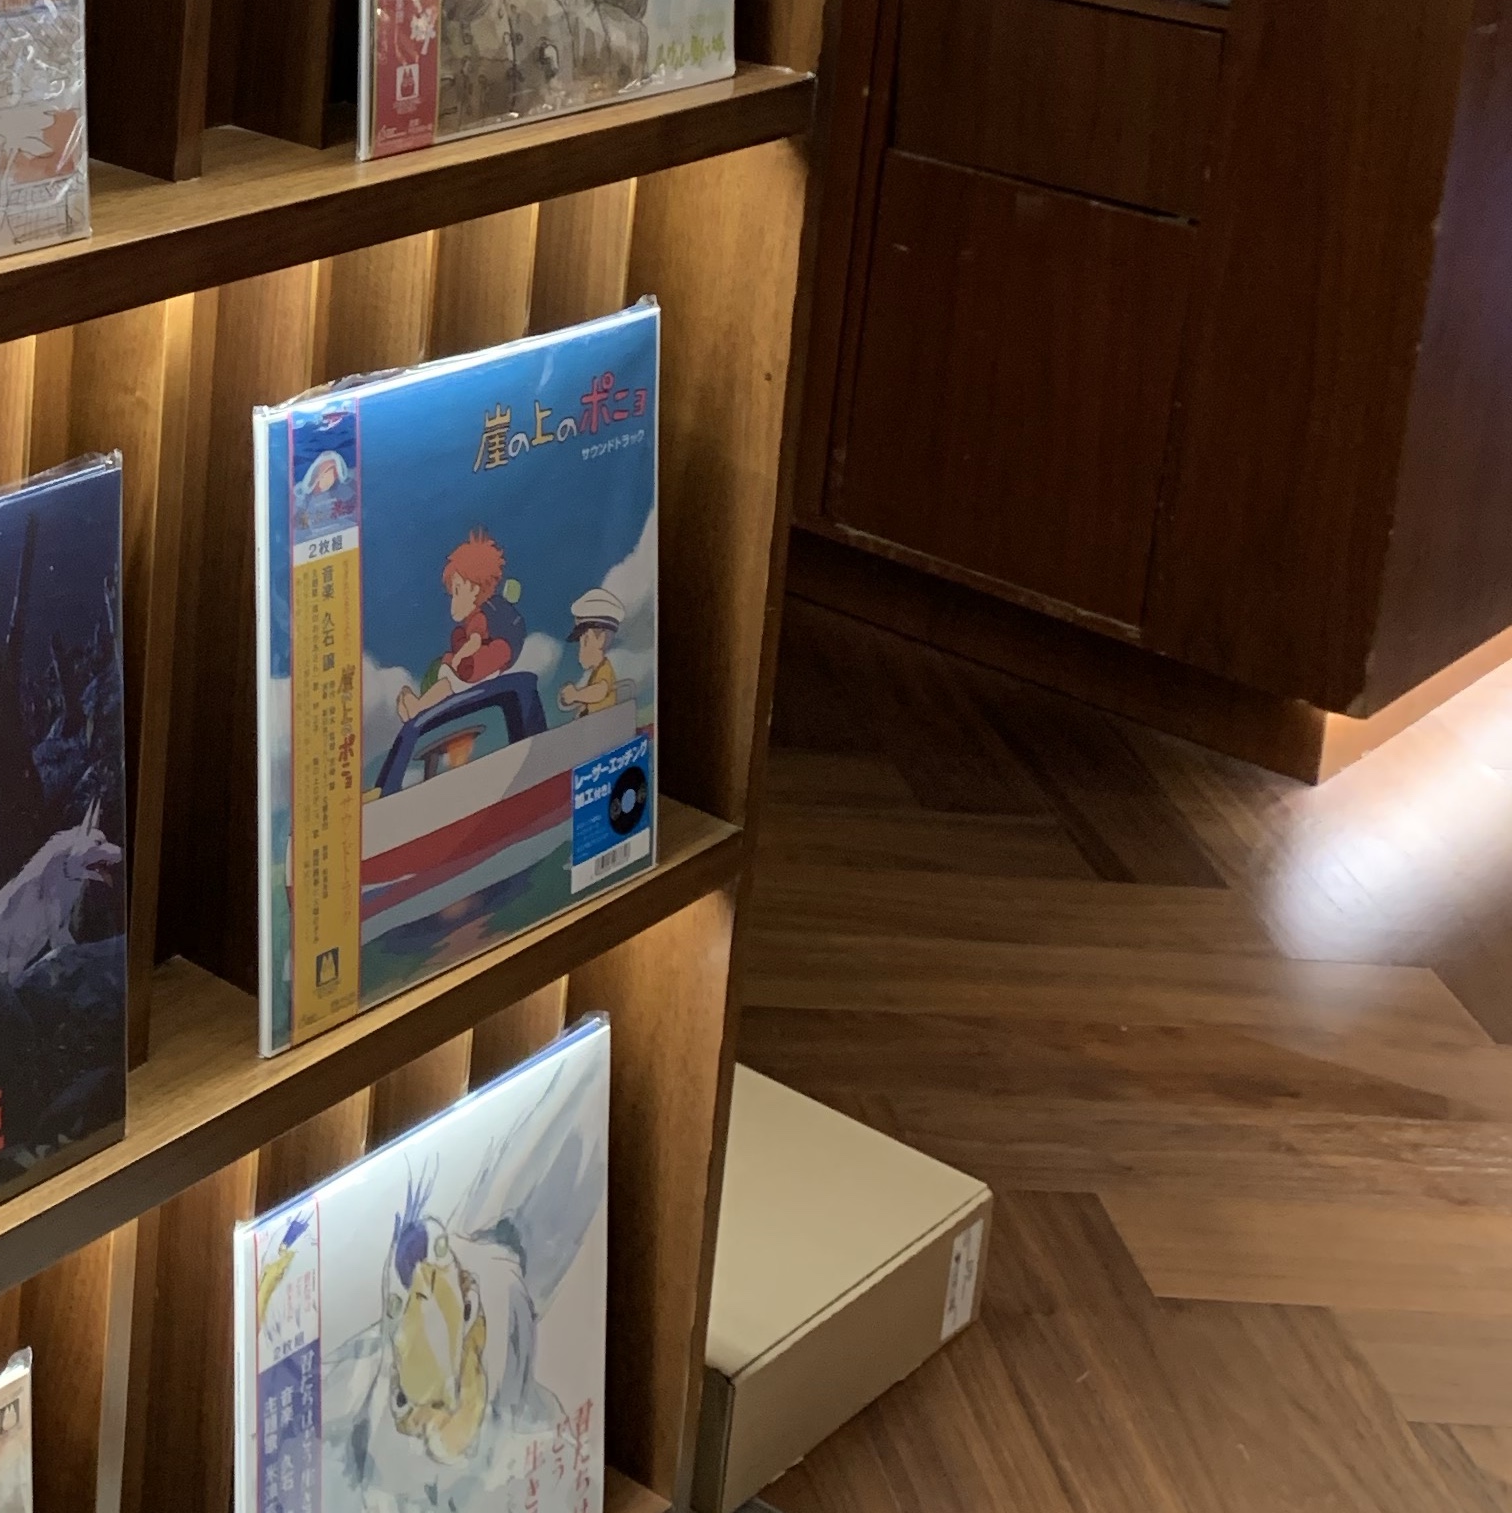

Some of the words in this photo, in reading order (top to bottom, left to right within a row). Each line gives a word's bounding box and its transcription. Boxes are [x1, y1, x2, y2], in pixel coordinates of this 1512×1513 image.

[472, 370, 649, 474] 崖の上のポニョ
[307, 534, 344, 560] 2枚組
[321, 565, 335, 601] 音楽
[321, 611, 336, 647] 久石
